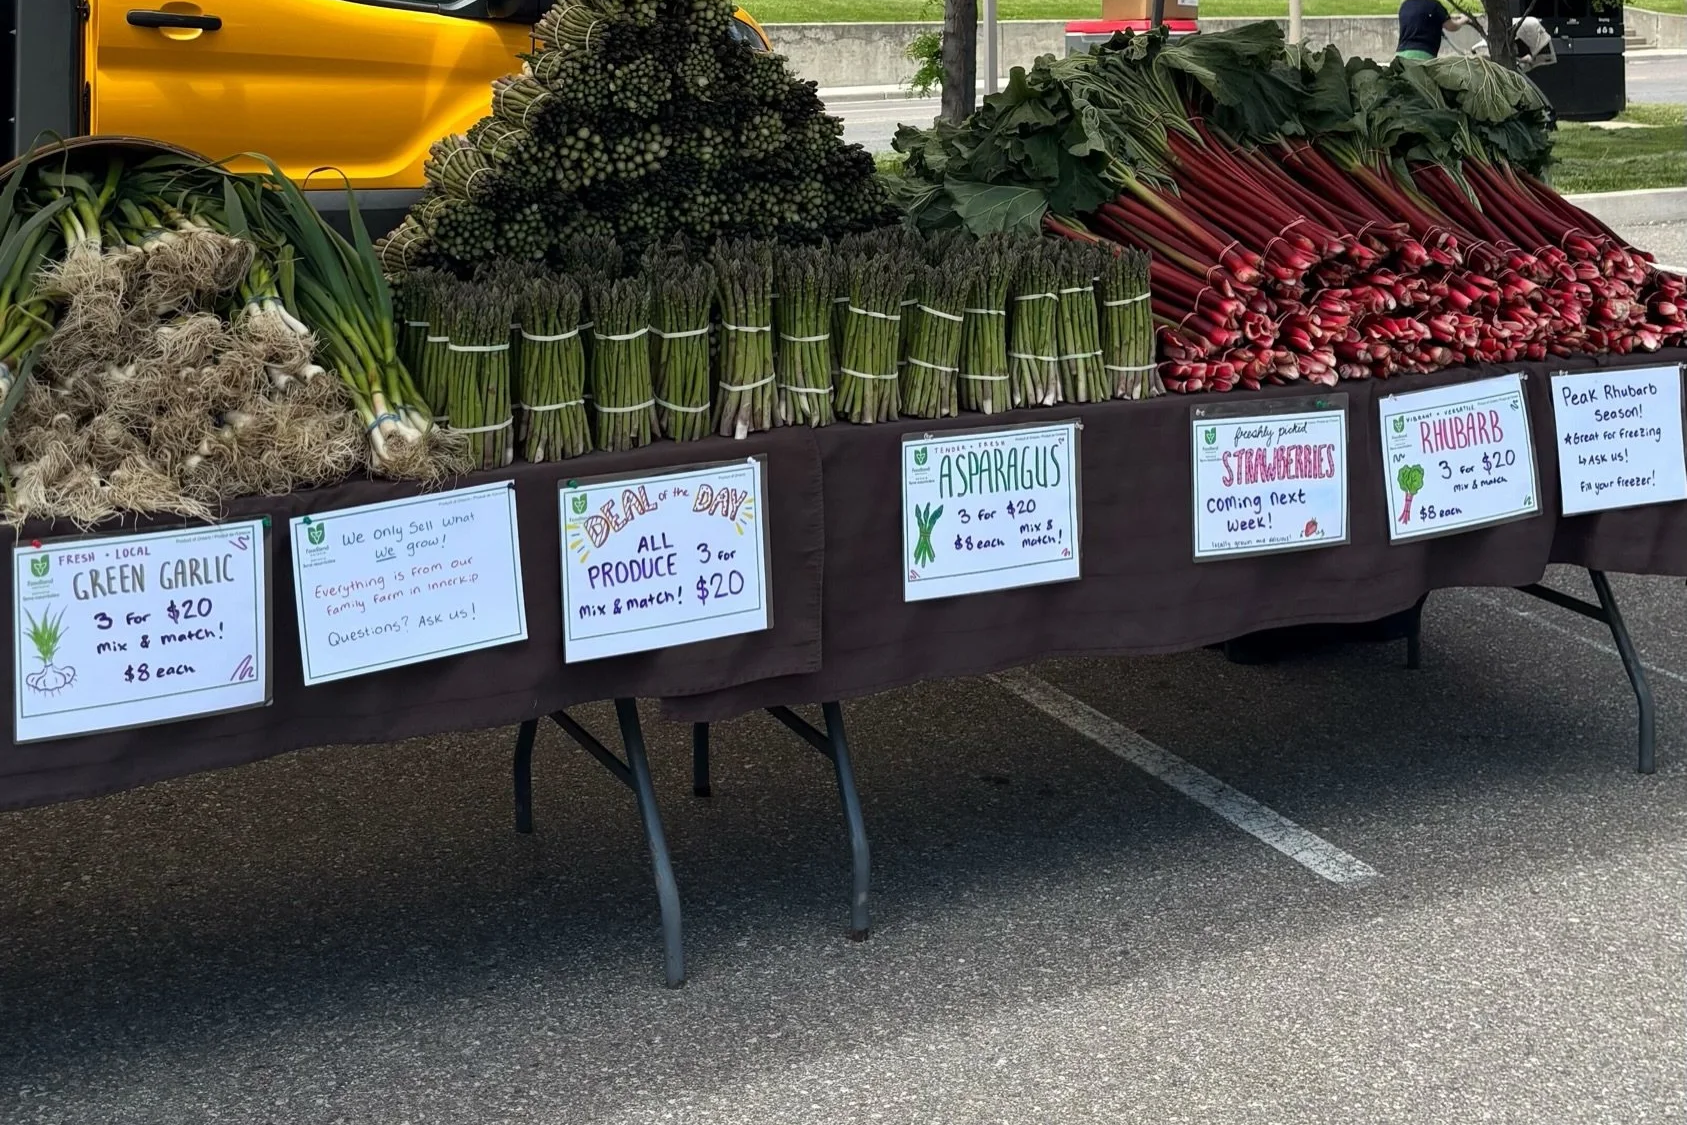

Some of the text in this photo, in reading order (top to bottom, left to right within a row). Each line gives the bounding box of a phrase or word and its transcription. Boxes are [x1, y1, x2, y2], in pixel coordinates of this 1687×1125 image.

[1562, 383, 1657, 407] Peak Rhubarb
[1406, 413, 1432, 422] VIBRANT
[1234, 421, 1308, 447] freshly picked
[1420, 410, 1503, 454] RHUBARB
[934, 445, 966, 453] TENDER
[939, 443, 1061, 499] ASPARAGUS
[1222, 443, 1335, 487] STRAWBERRIES
[1438, 460, 1452, 480] 3
[1482, 449, 1515, 475] $20
[1270, 488, 1306, 506] next
[1595, 480, 1614, 496] your
[584, 483, 748, 548] DEAL of the DAY
[958, 509, 971, 524] 3
[1006, 499, 1036, 519] $20
[1420, 505, 1462, 521] $8 each
[342, 532, 365, 546] We
[407, 534, 447, 556] grow!
[637, 532, 674, 553] ALL
[954, 534, 1005, 551] $8 each
[58, 545, 151, 566] FRESH LOCAL
[696, 542, 711, 564] 3
[73, 553, 235, 601] GREEN GARLIC
[315, 576, 386, 599] Everything
[394, 571, 405, 581] is
[450, 556, 473, 569] our
[587, 553, 678, 590] PRODUCE
[410, 586, 421, 595] in
[696, 569, 745, 606] $20
[94, 612, 113, 630] 3
[167, 597, 212, 624] $20
[613, 598, 622, 615] &
[328, 602, 476, 647] Questions? Ask us!
[140, 634, 150, 649] &
[124, 663, 196, 683] $8 each
